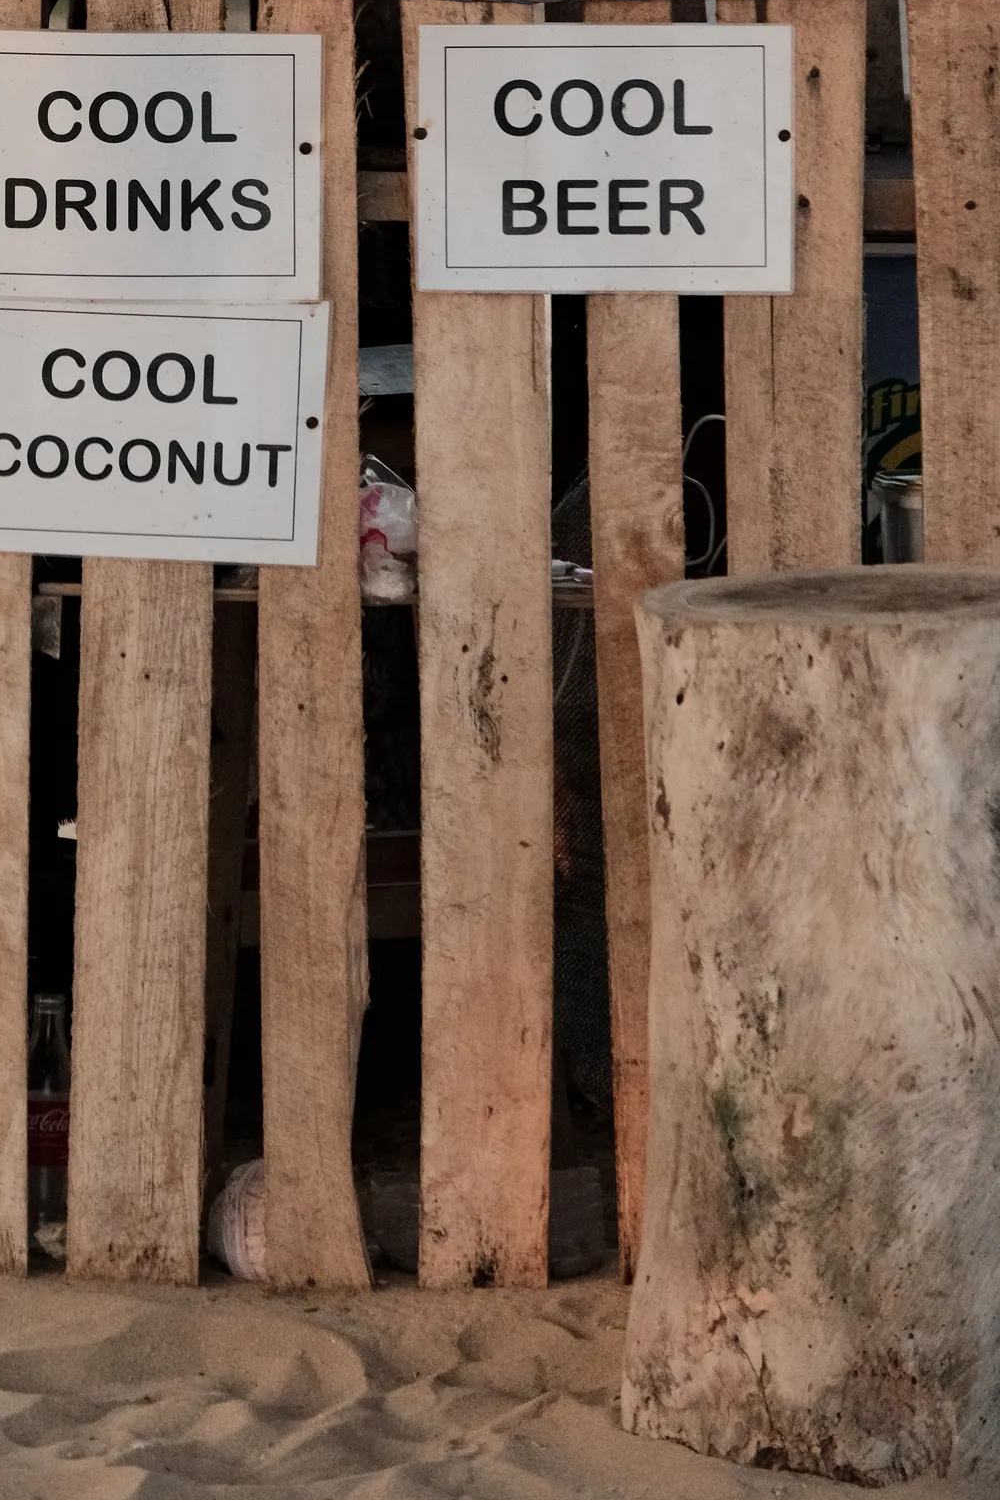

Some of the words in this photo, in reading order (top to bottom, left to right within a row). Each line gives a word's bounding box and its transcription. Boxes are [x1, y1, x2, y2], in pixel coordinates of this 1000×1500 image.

[37, 91, 238, 143] COOL
[494, 79, 712, 136] COOL
[4, 178, 272, 231] DRINKS
[502, 179, 706, 236] BEER
[41, 348, 238, 405] COOL
